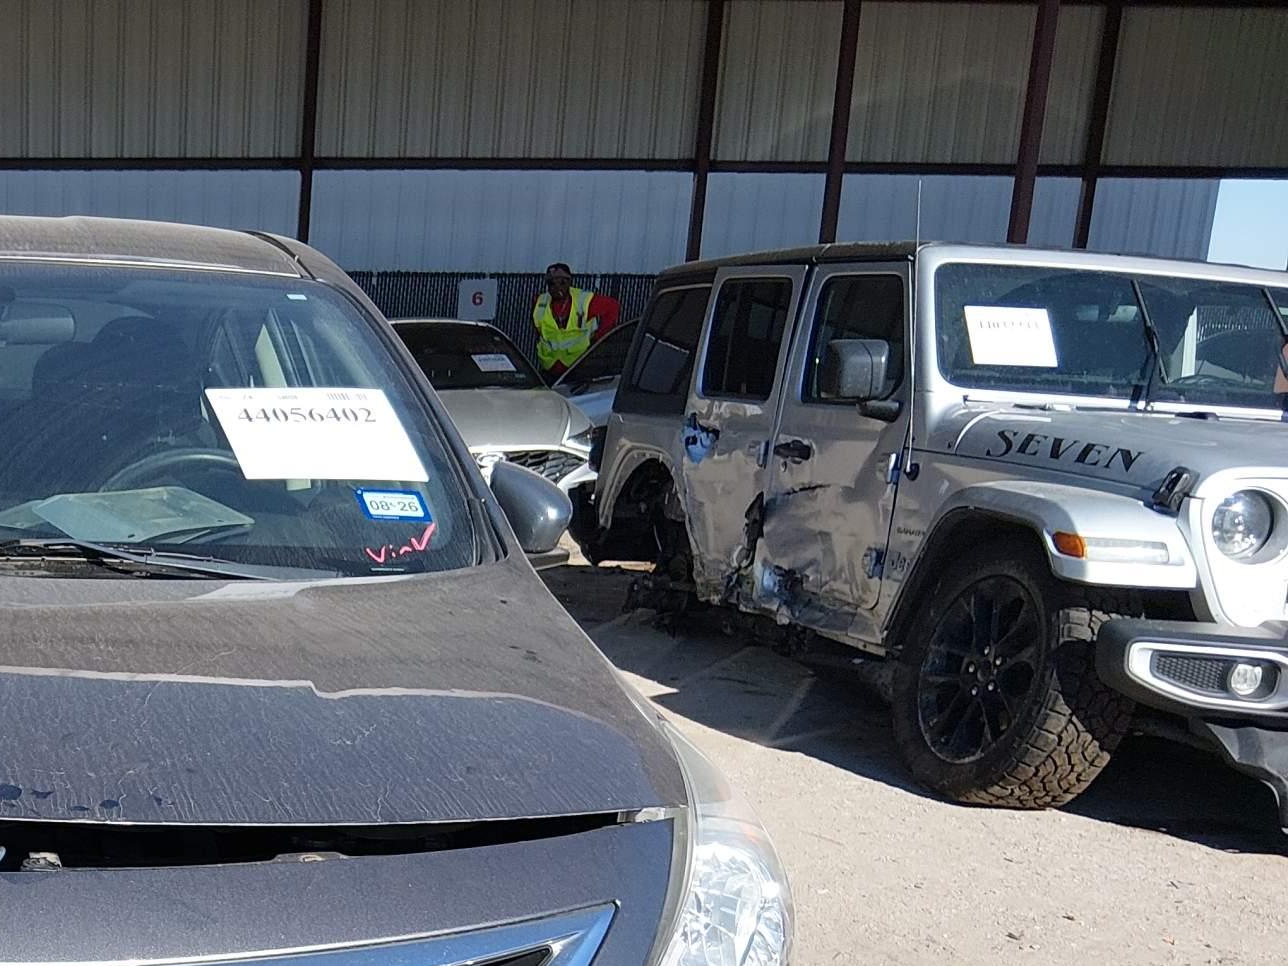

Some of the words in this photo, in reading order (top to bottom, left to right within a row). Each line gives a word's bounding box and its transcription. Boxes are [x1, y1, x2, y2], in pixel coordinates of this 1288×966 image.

[471, 291, 484, 306] 6
[237, 407, 377, 423] 44056402
[985, 428, 1145, 473] SEVEN
[398, 501, 419, 512] 26
